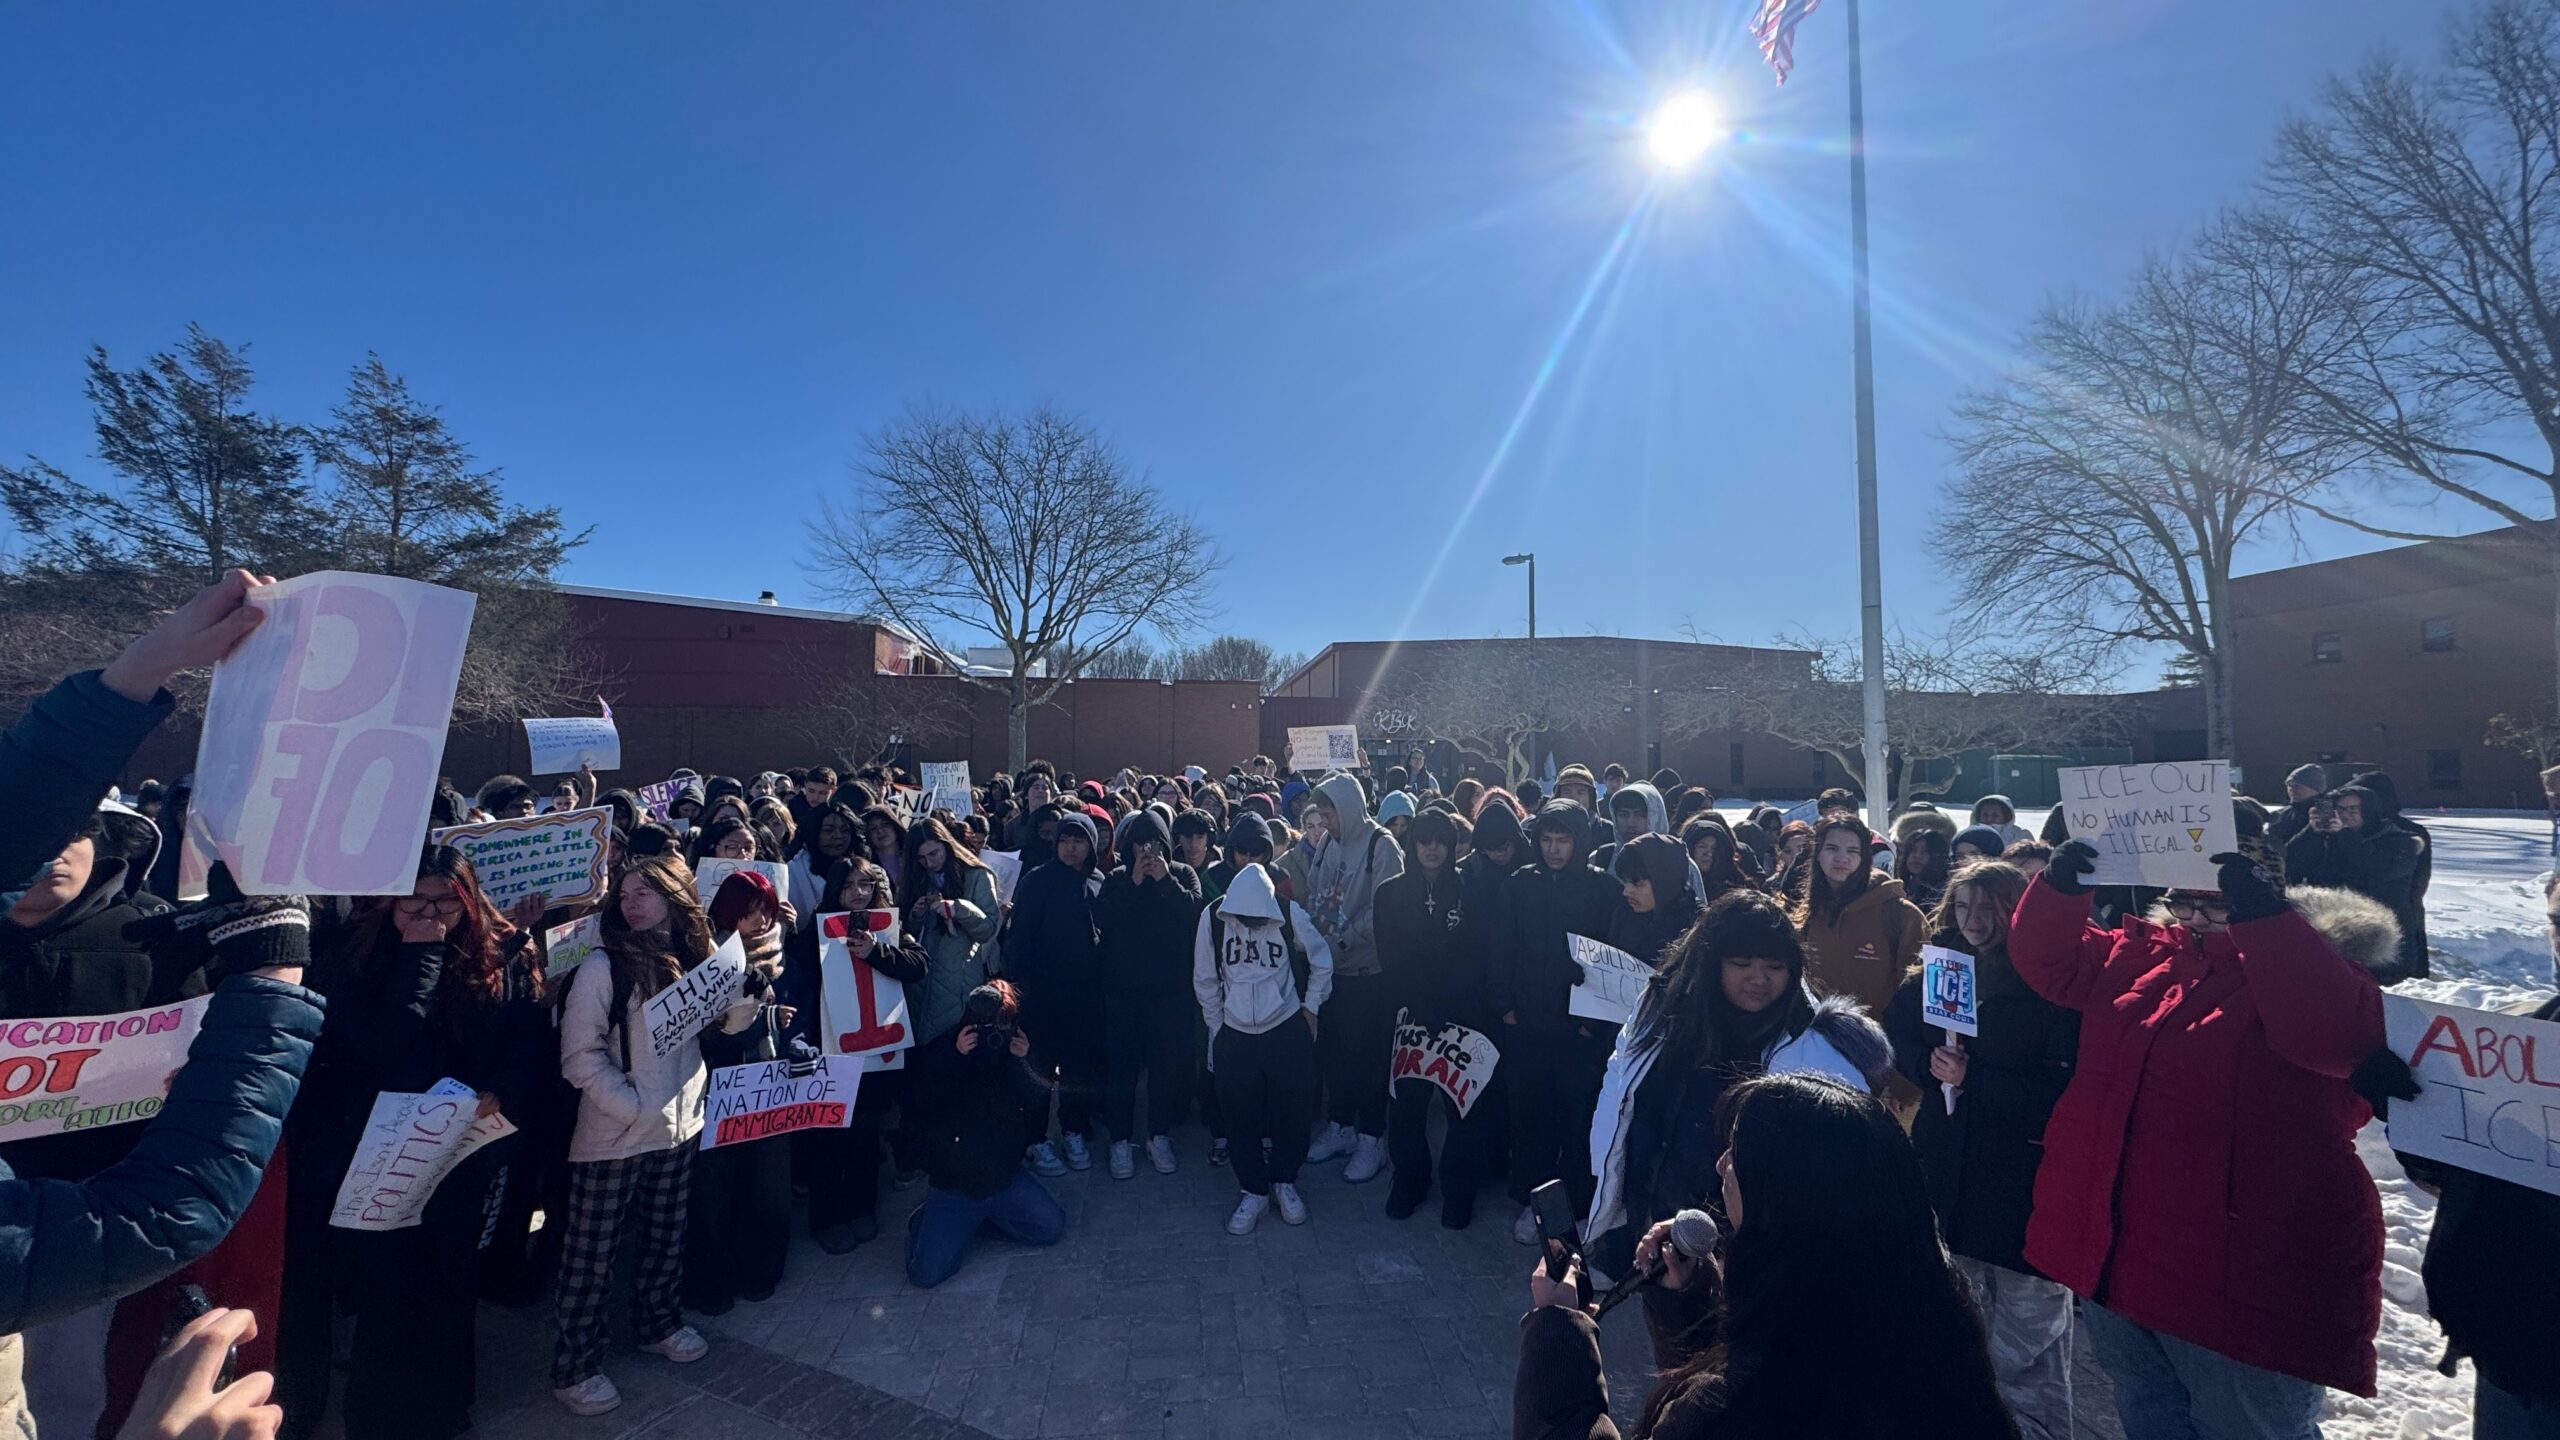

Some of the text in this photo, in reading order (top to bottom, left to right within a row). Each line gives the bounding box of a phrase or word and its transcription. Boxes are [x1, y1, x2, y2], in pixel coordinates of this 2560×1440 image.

[2072, 765, 2142, 800] ICE
[903, 791, 933, 814] NO
[2072, 810, 2098, 829] NO
[2180, 805, 2211, 823] IS
[464, 828, 583, 857] SOMEWHERE IN
[529, 848, 541, 858] A
[545, 838, 593, 855] LITTLE
[488, 870, 506, 882] IS
[510, 860, 564, 877] HIDING
[568, 856, 588, 868] IN
[530, 870, 590, 887] WRITING
[1226, 935, 1283, 968] GAP
[651, 959, 720, 1016] THIS
[652, 960, 739, 1041] ENDS WHEN
[704, 994, 720, 1011] OF
[657, 997, 730, 1059] SAY NO
[2408, 1015, 2560, 1088] ABOL
[0, 1049, 102, 1100] OT
[716, 1057, 829, 1091] WE AR A
[63, 1096, 165, 1131] ATIO
[714, 1080, 837, 1121] NATION OF
[717, 1103, 844, 1145] IMMIGRANTS
[361, 1101, 458, 1222] POLITICS
